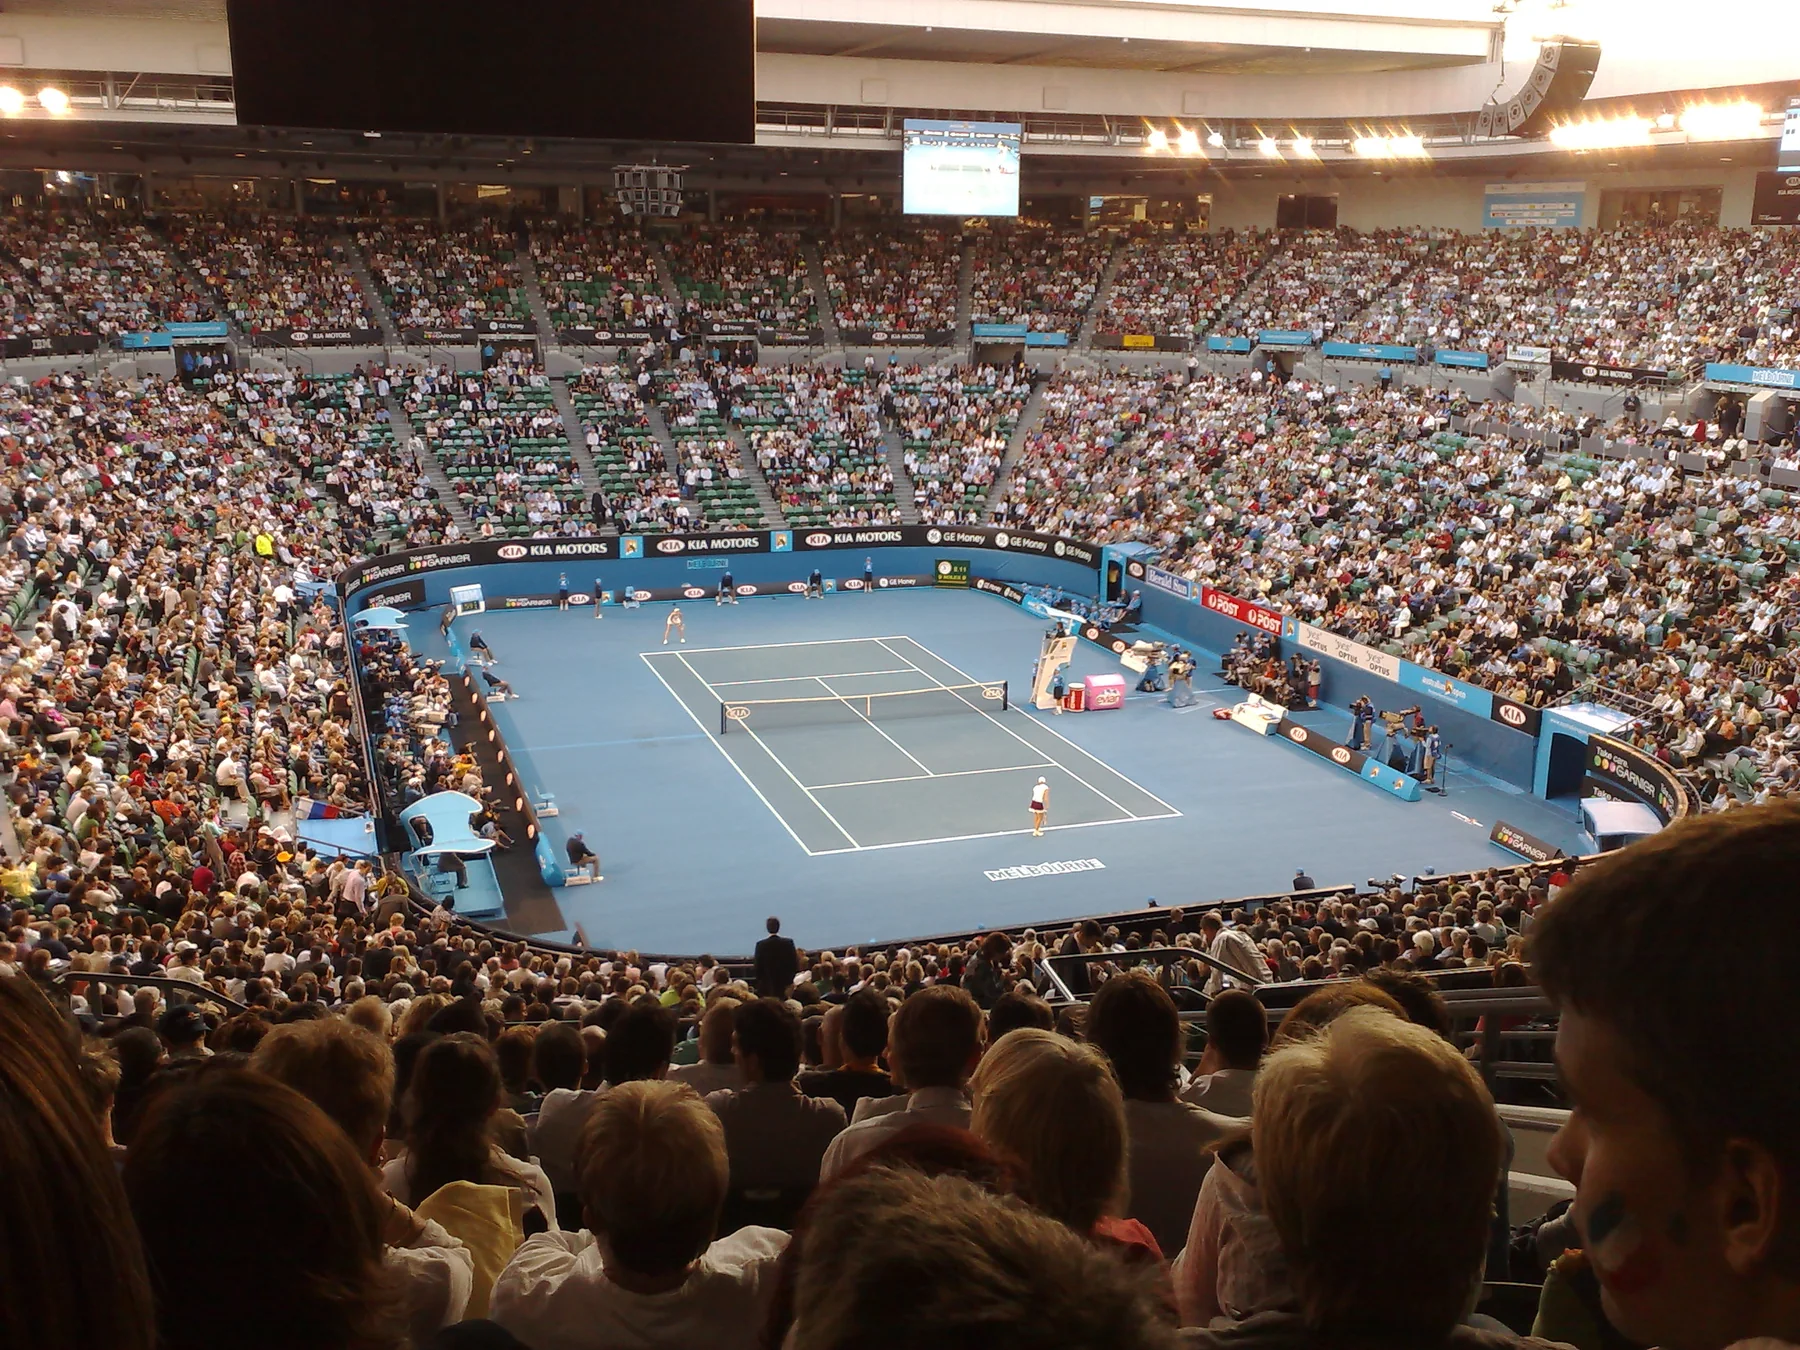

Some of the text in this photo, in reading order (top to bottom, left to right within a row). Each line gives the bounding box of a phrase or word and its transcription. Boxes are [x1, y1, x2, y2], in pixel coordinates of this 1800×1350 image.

[1610, 371, 1633, 379] MOTORS
[688, 537, 759, 550] KIA MOTORS
[835, 531, 902, 543] KIA MOTORS
[943, 533, 986, 546] GE Money
[531, 543, 608, 556] KIA MOTORS
[1010, 538, 1047, 552] GE Money
[427, 554, 471, 568] GARNIER
[372, 564, 405, 580] GARNIER
[899, 579, 916, 587] Money
[1150, 569, 1188, 593] Herald Sun
[520, 599, 552, 607] GARNIER
[1217, 599, 1240, 617] POST
[1257, 611, 1281, 633] POST
[1310, 640, 1328, 653] OPTUS
[1338, 650, 1358, 664] OPTUS
[1369, 662, 1390, 677] OPTUS
[1595, 746, 1612, 761] Take
[1615, 765, 1656, 798] GARNIER
[1592, 786, 1612, 801] Take
[1512, 839, 1548, 861] GARNIER
[985, 858, 1103, 881] MELBOURNE
